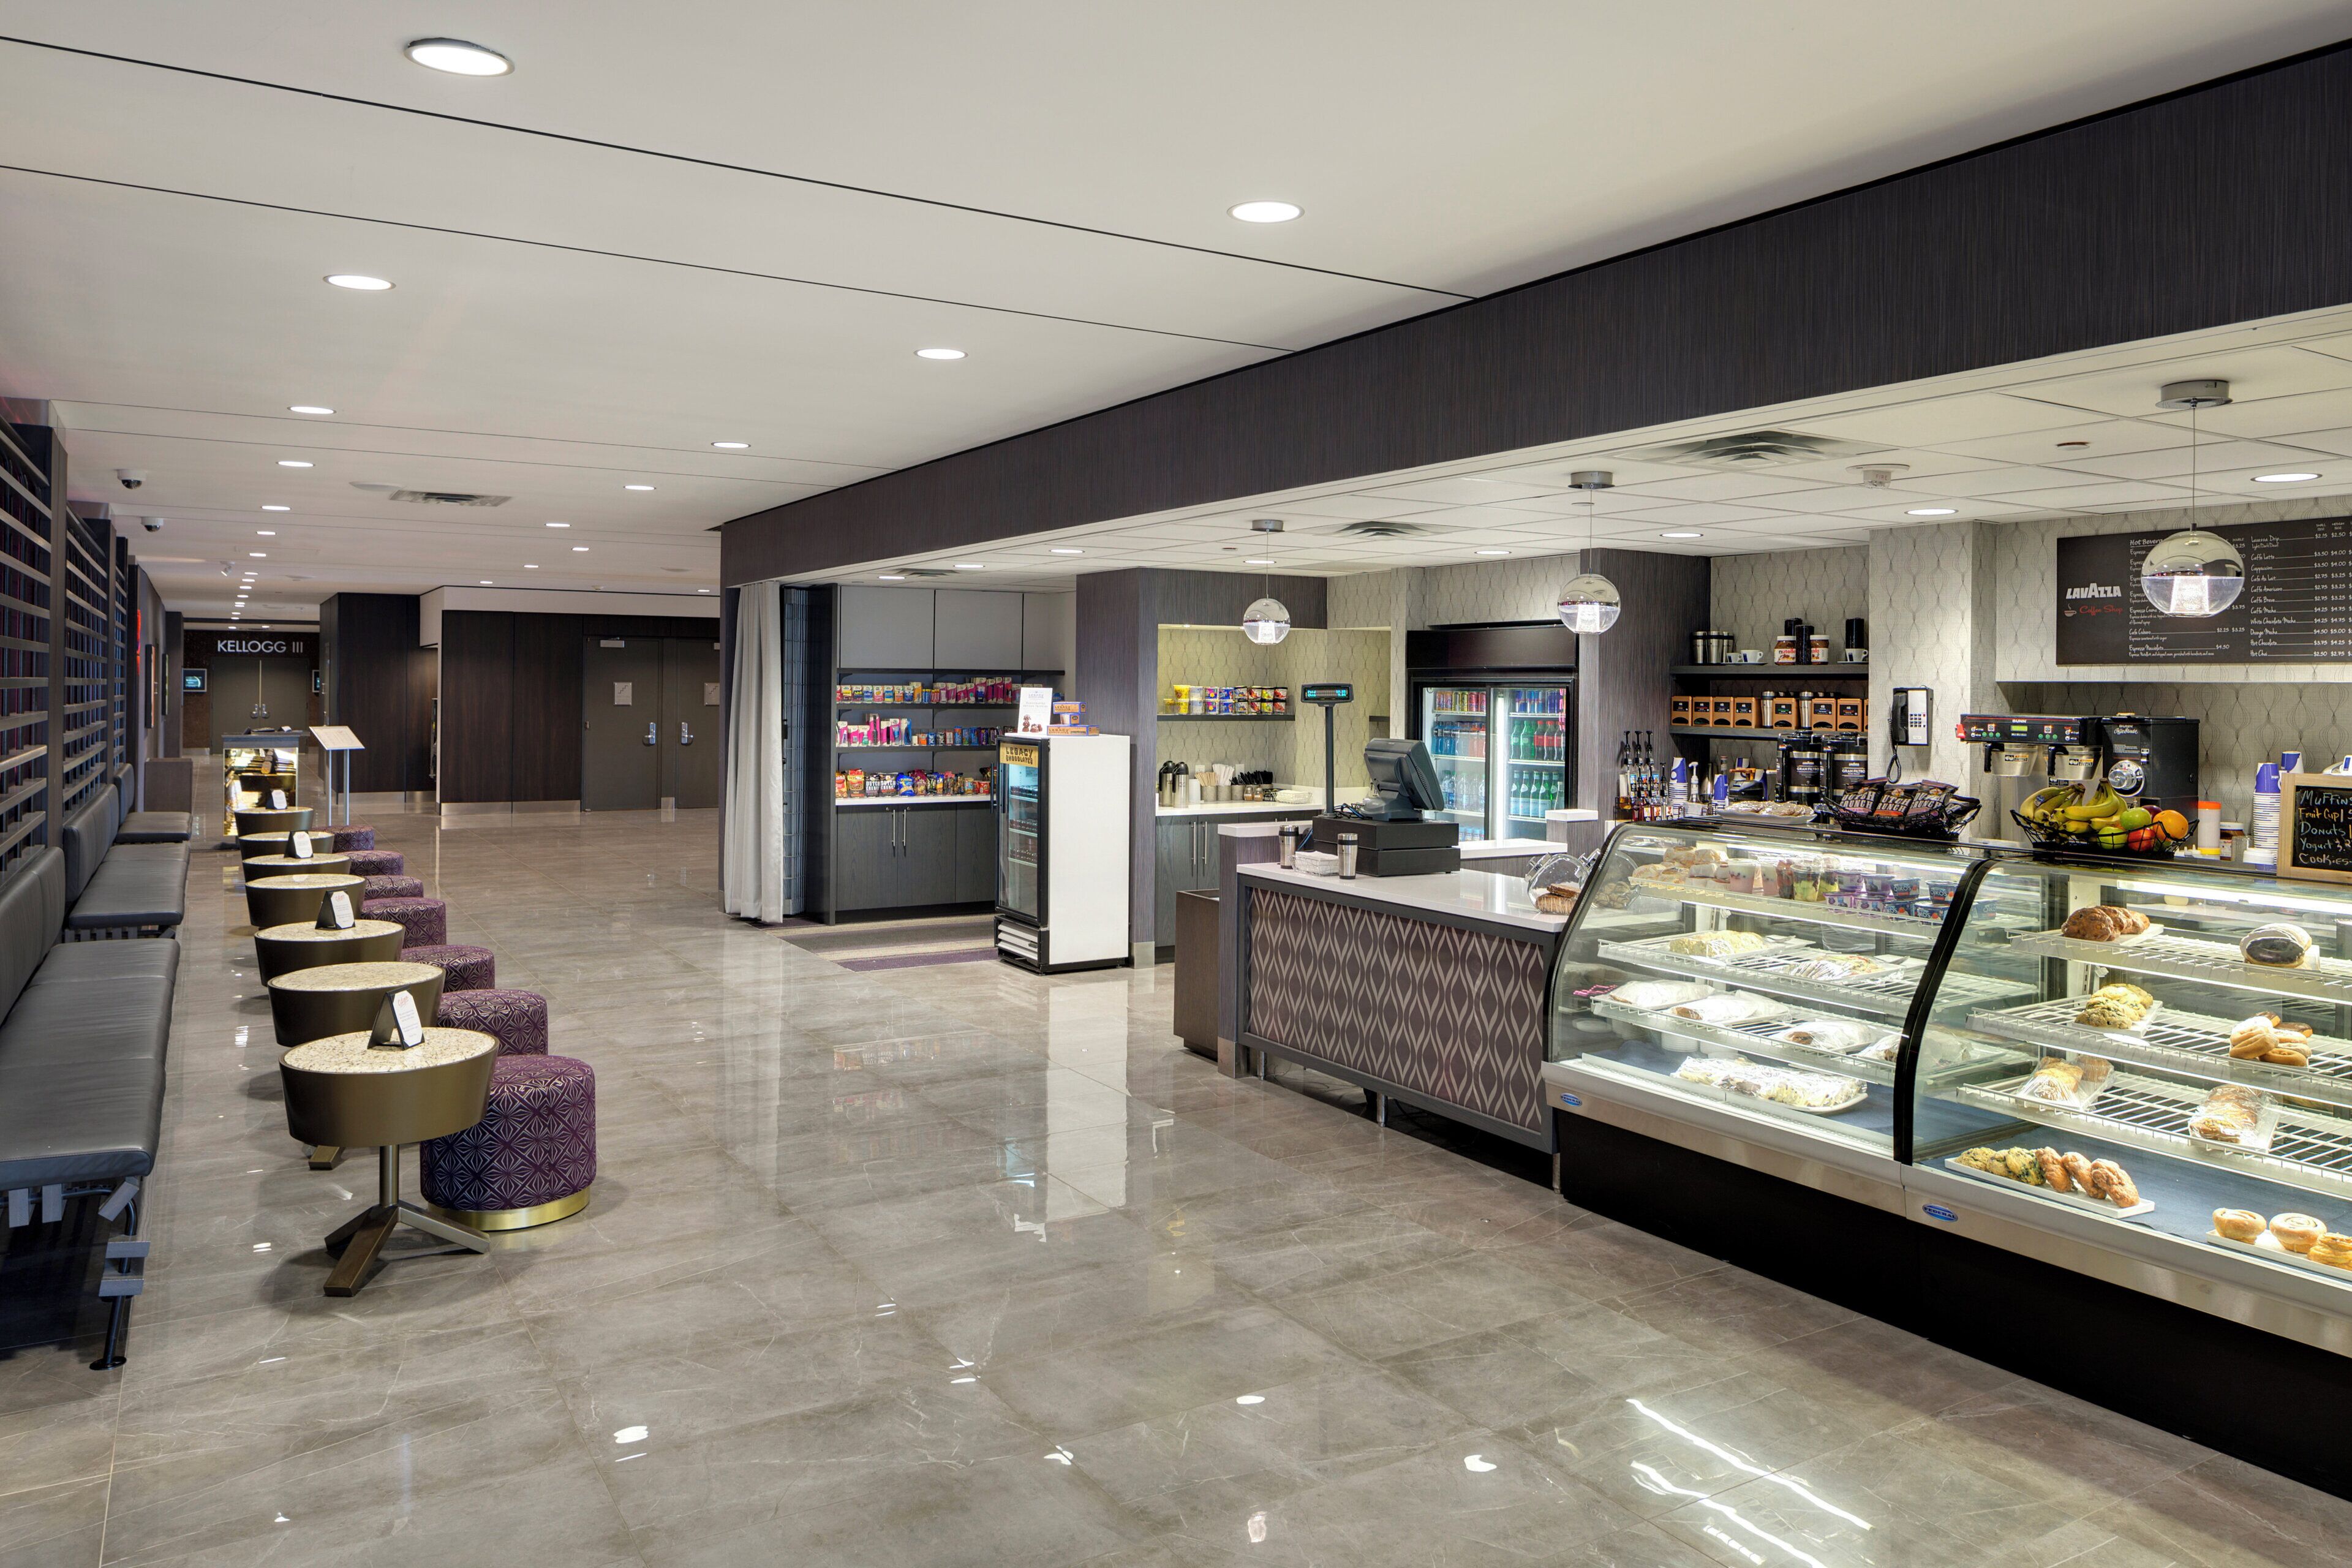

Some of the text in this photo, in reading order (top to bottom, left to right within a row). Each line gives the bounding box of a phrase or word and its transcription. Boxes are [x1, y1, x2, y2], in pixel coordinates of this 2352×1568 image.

[2269, 535, 2280, 544] Drip
[2066, 582, 2122, 599] LAVAZZA
[2079, 604, 2123, 616] Coffee Shop
[2250, 629, 2264, 638] Orange
[217, 640, 303, 653] KELLOGG III
[1006, 747, 1033, 758] LEGACY
[1006, 755, 1033, 764] CHOCOLATES
[1842, 791, 1876, 801] DUTCH
[1882, 794, 1912, 805] UTCH
[1877, 803, 1906, 812] RUNCH
[2298, 807, 2322, 820] Fruit
[2324, 809, 2339, 822] Cup
[2300, 838, 2331, 852] Yogurt
[1924, 1206, 1956, 1219] FEDERAL
